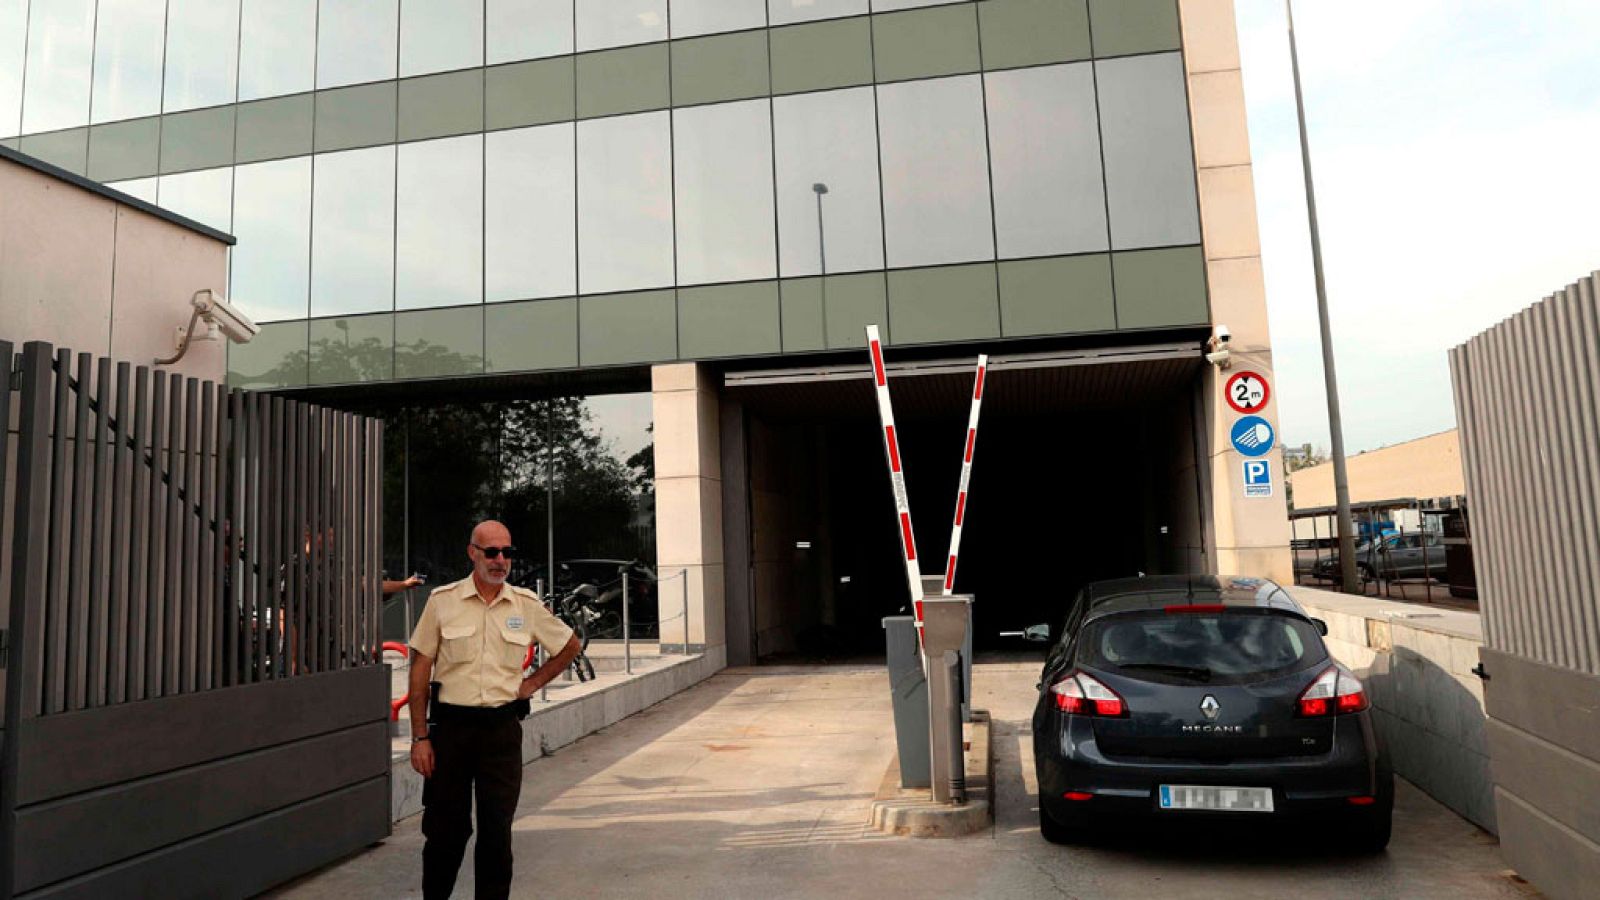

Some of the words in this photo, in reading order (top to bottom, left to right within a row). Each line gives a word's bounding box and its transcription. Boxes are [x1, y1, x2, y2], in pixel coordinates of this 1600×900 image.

[1235, 383, 1249, 401] 2
[1251, 391, 1262, 399] m
[1247, 463, 1265, 483] P
